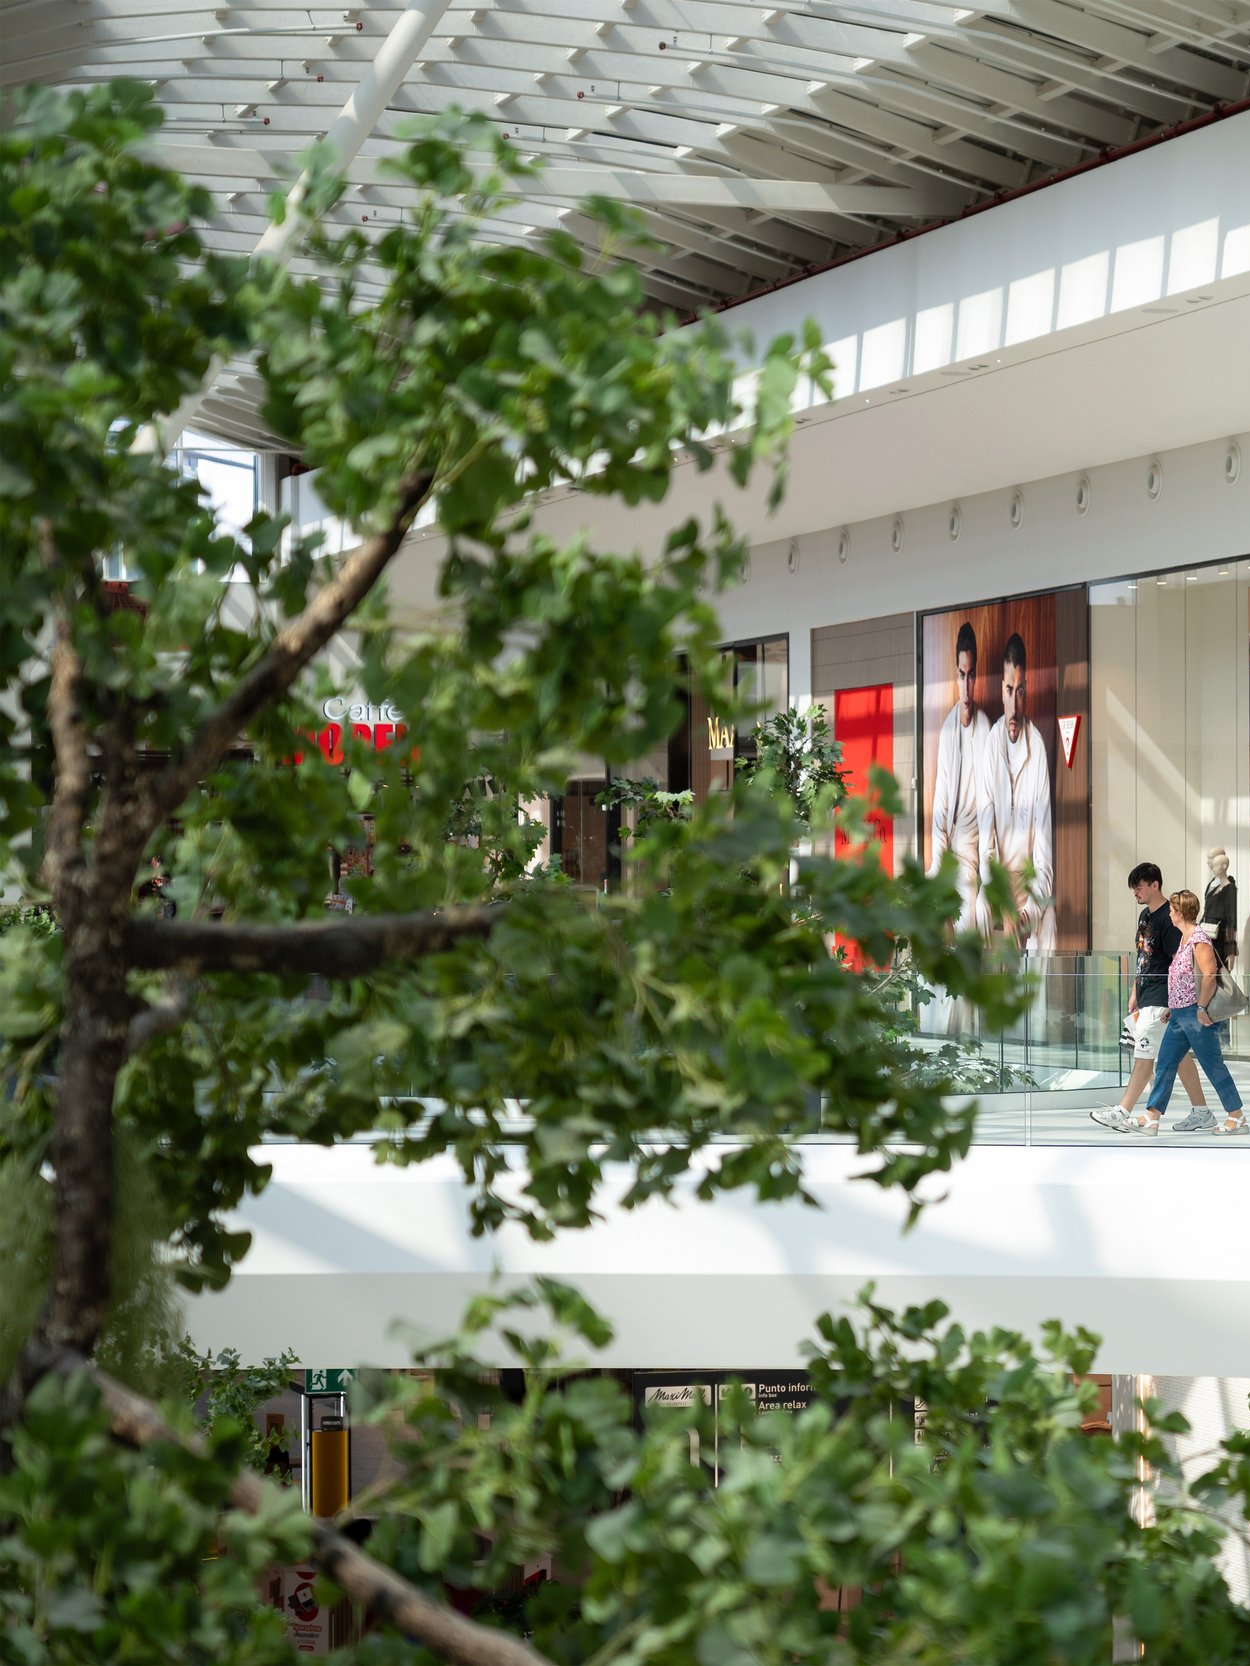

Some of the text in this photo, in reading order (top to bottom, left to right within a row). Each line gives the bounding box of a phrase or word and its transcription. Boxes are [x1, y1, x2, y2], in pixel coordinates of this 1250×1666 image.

[758, 1384, 786, 1393] Punto
[758, 1400, 807, 1410] Area relax
